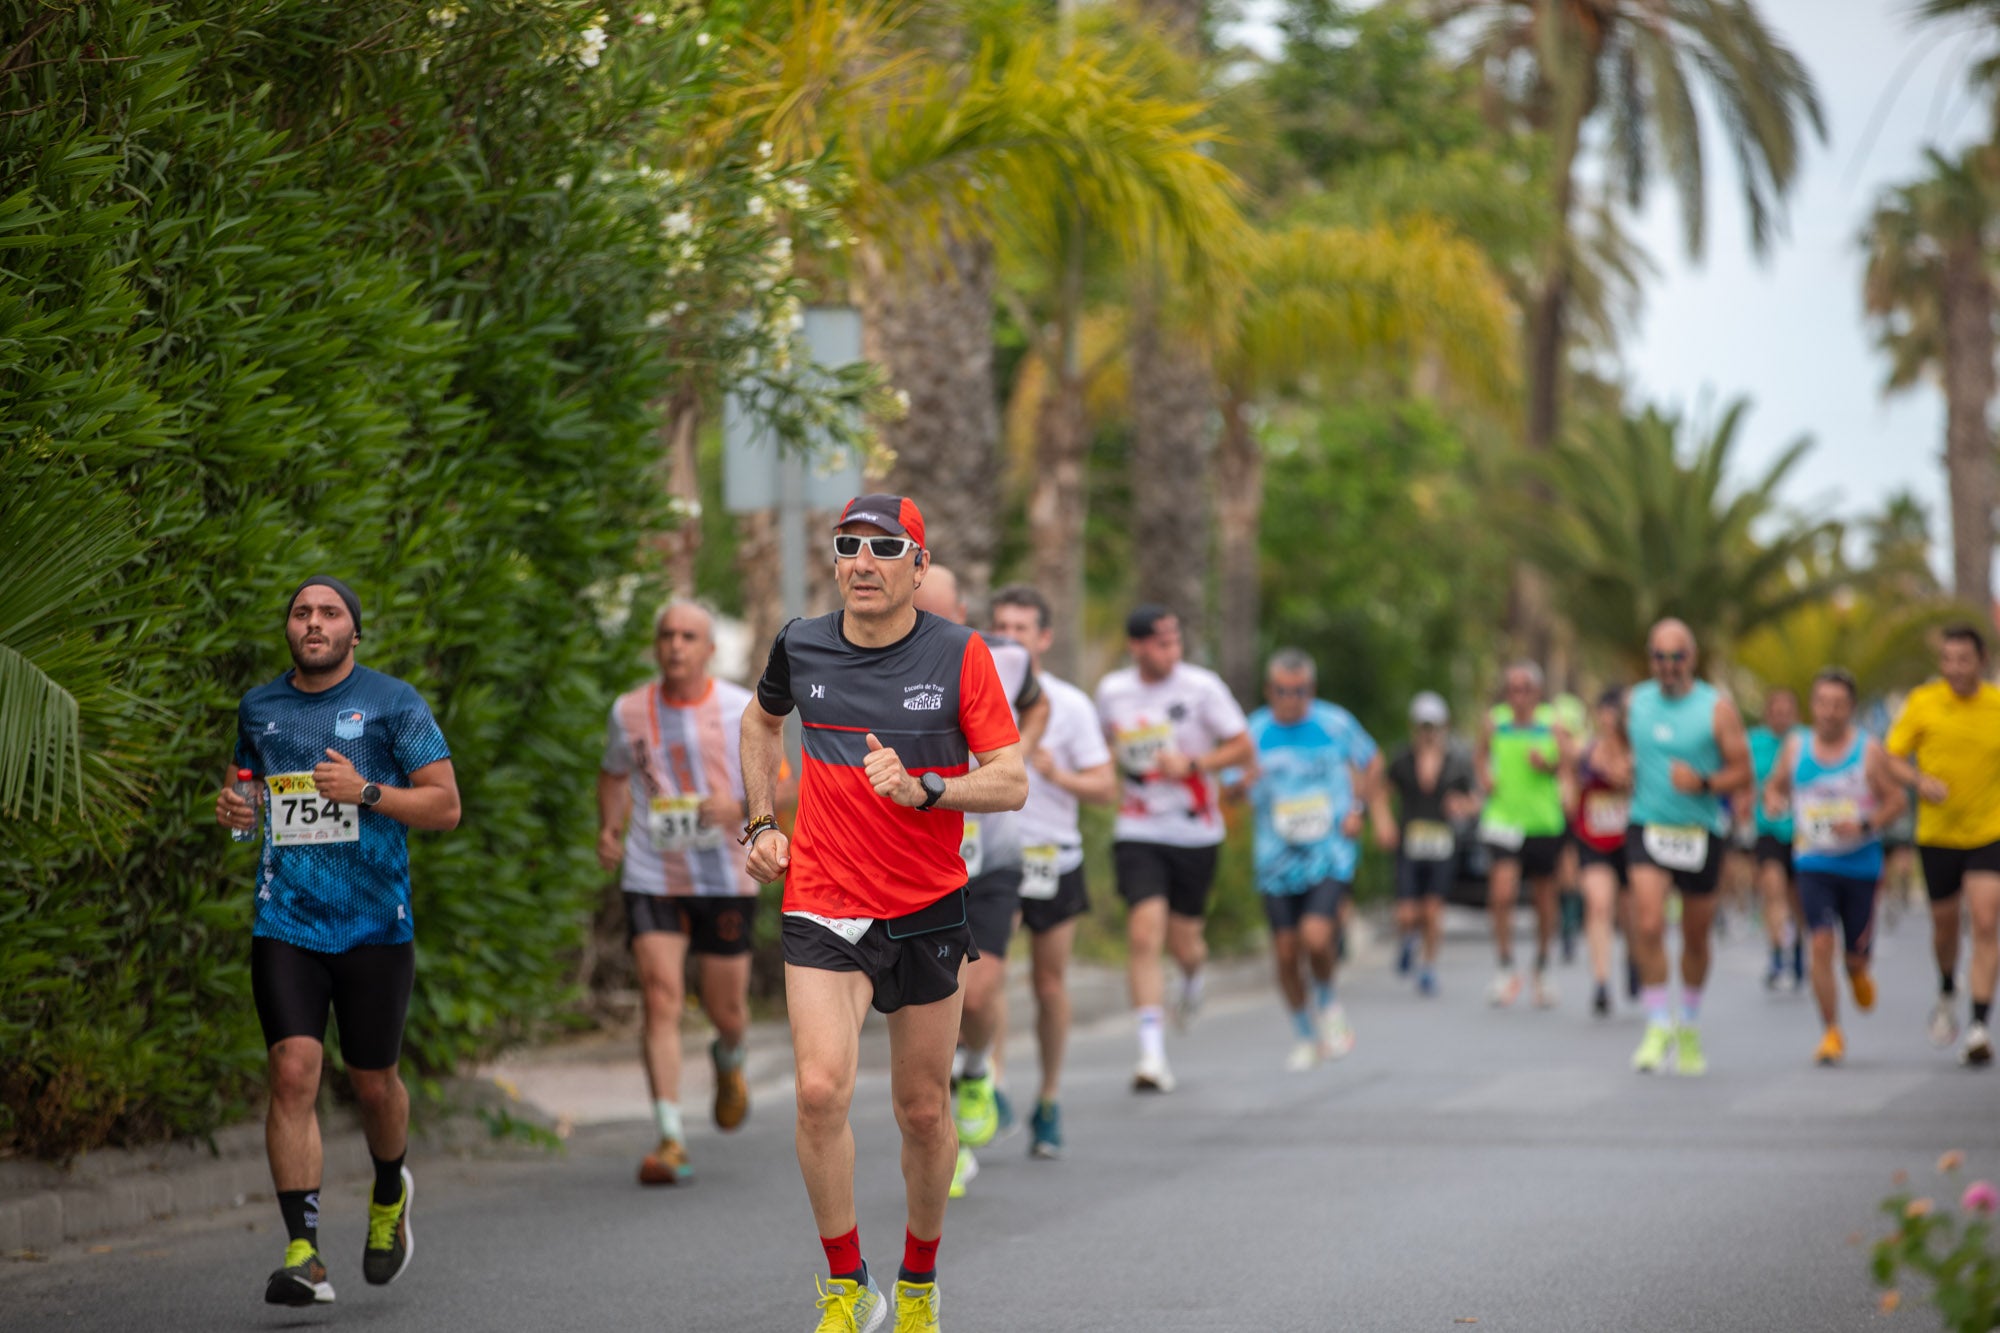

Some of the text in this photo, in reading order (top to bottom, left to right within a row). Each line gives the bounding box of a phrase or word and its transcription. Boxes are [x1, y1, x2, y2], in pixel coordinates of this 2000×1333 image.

[904, 683, 924, 693] Escuela
[932, 683, 945, 693] Trail
[906, 695, 941, 710] ATARFE
[281, 797, 343, 826] 754
